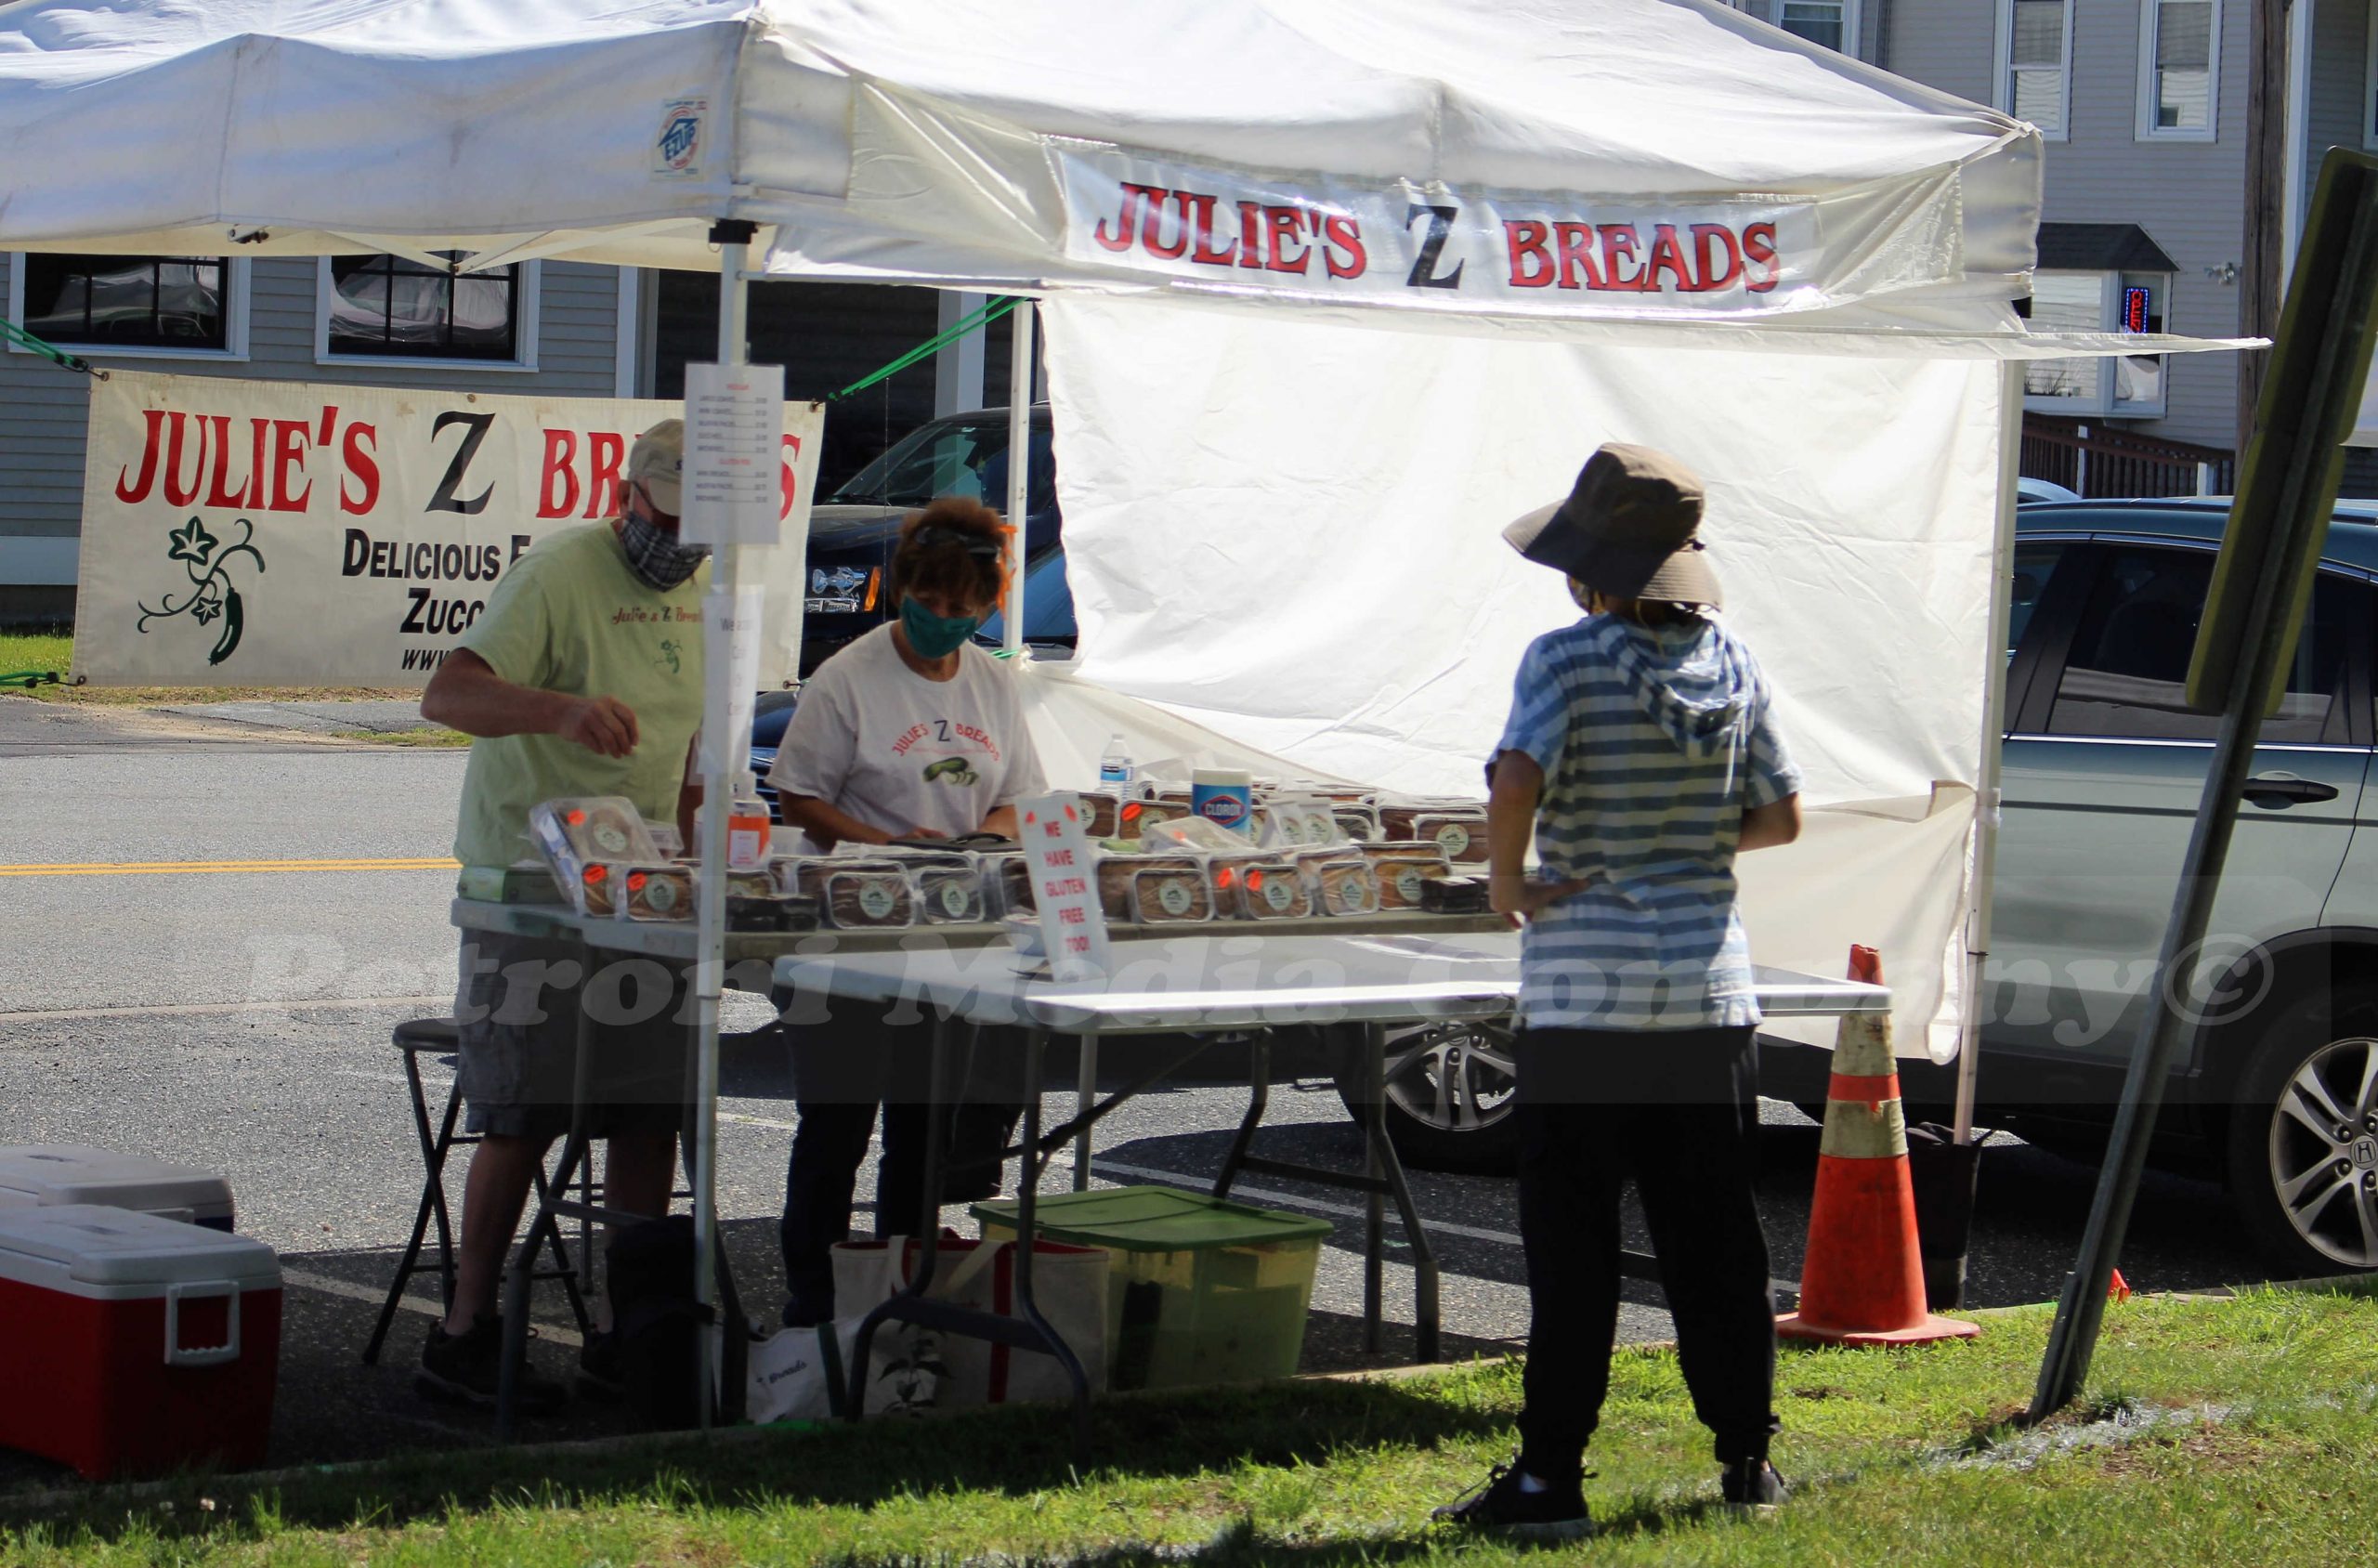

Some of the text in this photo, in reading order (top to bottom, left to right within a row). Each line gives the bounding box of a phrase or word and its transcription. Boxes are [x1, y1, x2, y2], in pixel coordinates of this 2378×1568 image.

[1094, 181, 1781, 295] JULIE'S Z BREADS
[115, 405, 802, 521] JULIE'S Z BRS
[342, 528, 502, 581] DELICIOUS
[399, 587, 486, 635] ZUCC
[934, 719, 951, 742] Z
[955, 722, 1000, 762] BREADS
[1043, 821, 1062, 838] WE
[1044, 849, 1075, 868] HAVE
[1044, 878, 1087, 897] GLUTEN
[1058, 907, 1086, 925] FREE
